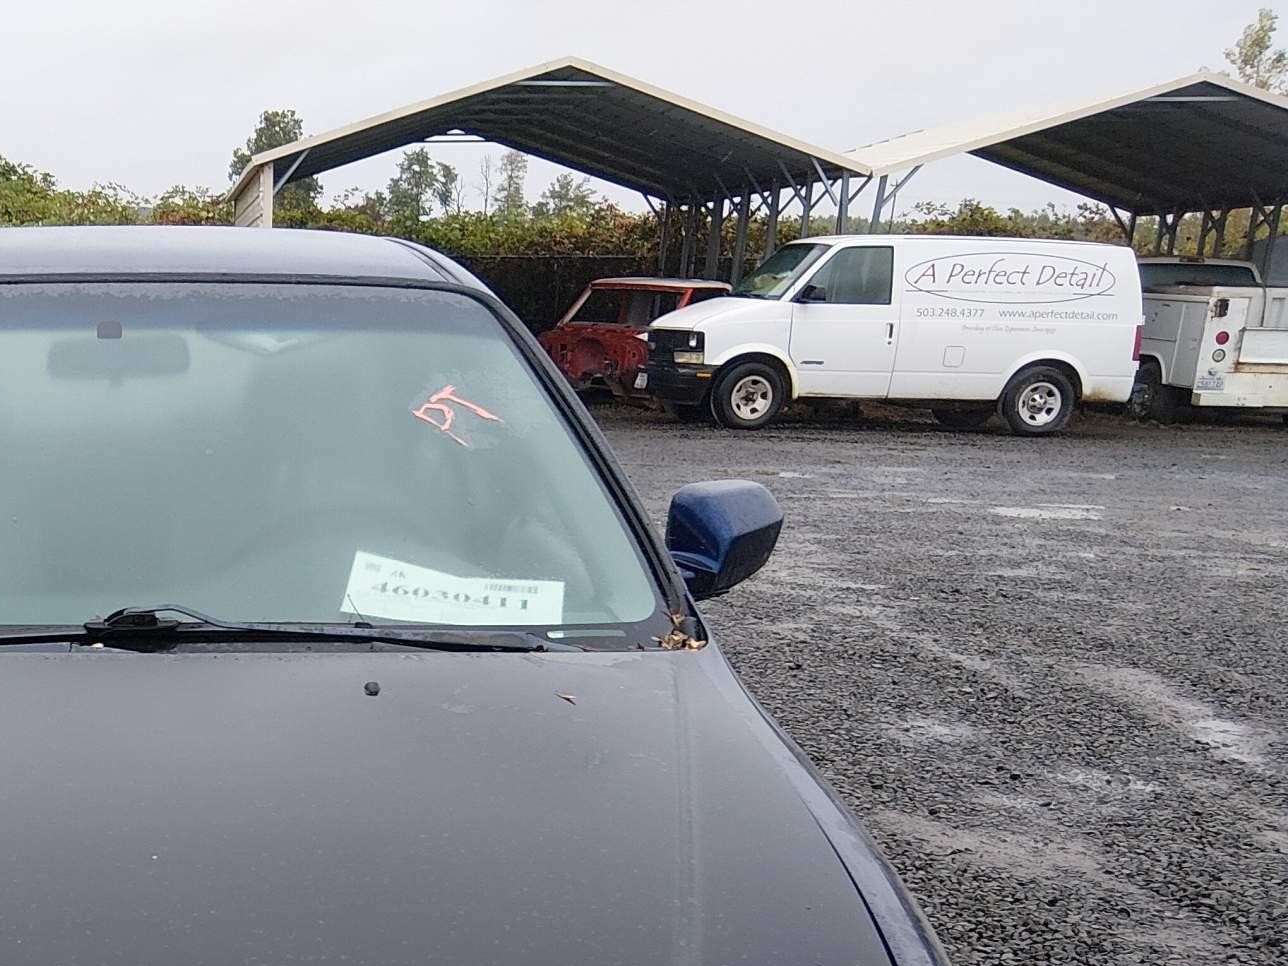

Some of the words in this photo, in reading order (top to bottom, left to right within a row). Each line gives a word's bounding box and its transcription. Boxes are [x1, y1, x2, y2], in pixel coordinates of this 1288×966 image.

[914, 263, 937, 285] A
[946, 258, 1031, 286] Perfect
[1036, 262, 1108, 289] Detail
[916, 308, 985, 318] 503.248.4377
[998, 308, 1118, 321] www.aperfectdetail.com
[371, 580, 529, 610] 46030411
